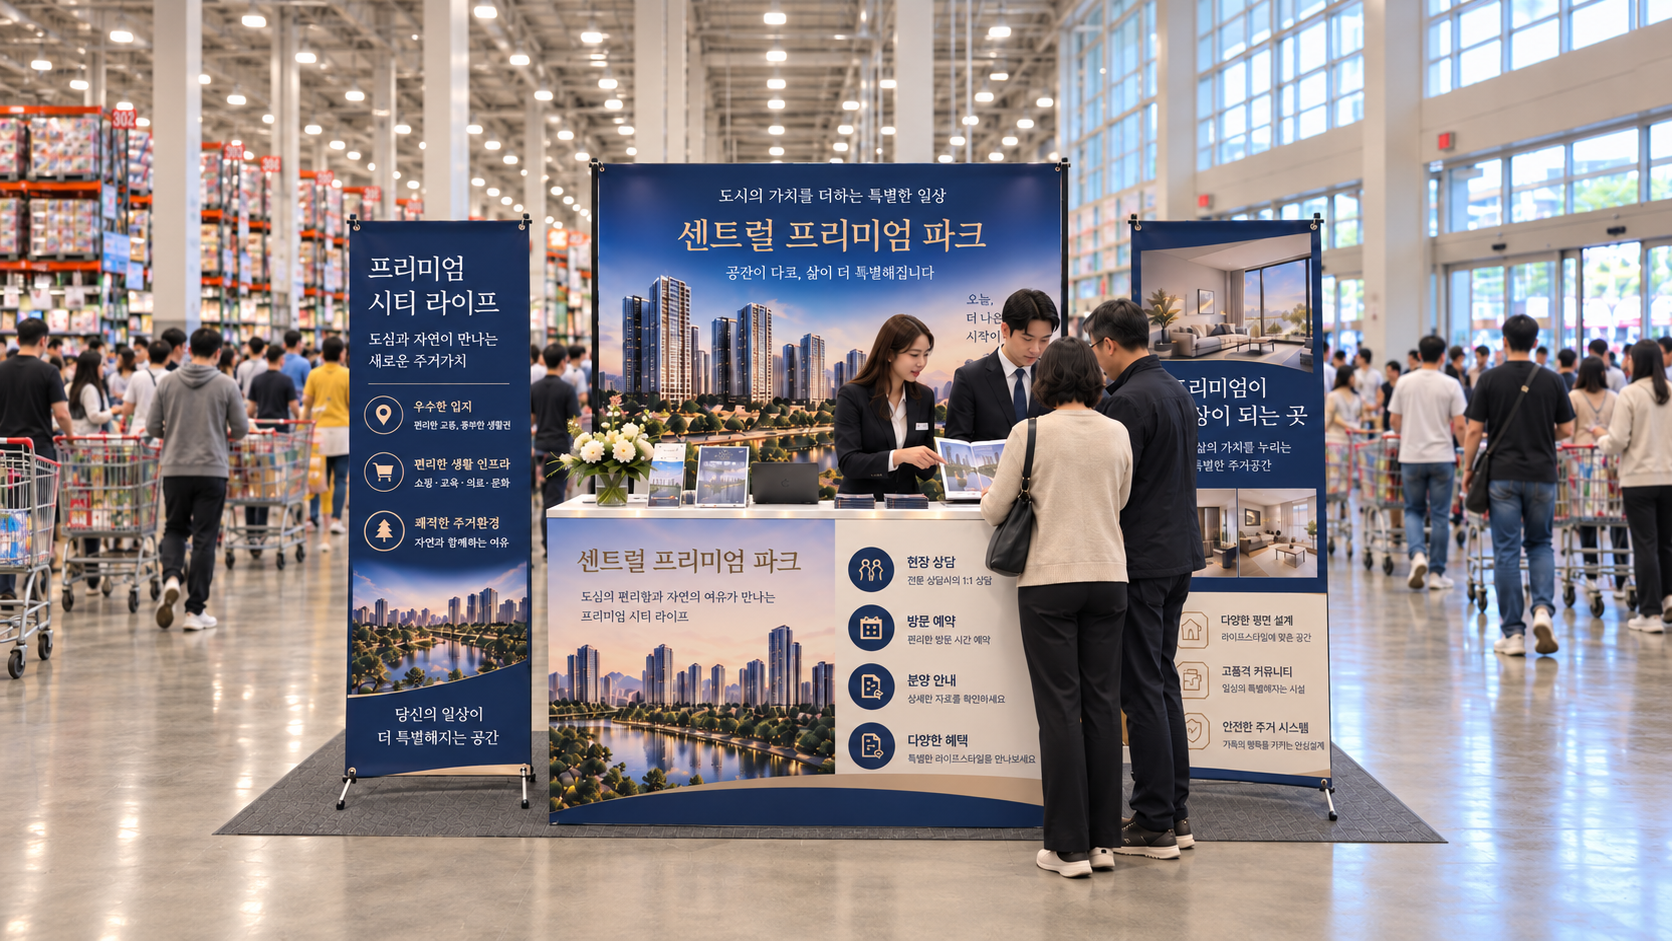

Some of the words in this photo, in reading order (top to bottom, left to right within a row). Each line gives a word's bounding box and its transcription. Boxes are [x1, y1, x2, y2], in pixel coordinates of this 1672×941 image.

[112, 111, 135, 127] 302
[719, 188, 762, 203] 도시의
[769, 188, 813, 203] 가치를
[819, 188, 863, 203] 더하는
[868, 188, 912, 203] 특별한
[918, 188, 946, 203] 일상
[678, 219, 773, 252] 센트럴
[786, 219, 910, 252] 프리미엄
[923, 219, 986, 252] 파크
[368, 255, 463, 281] 프리미엄
[726, 265, 766, 280] 공간이
[807, 265, 831, 280] 삶이
[838, 265, 849, 280] 더
[369, 290, 414, 316] 시티
[427, 290, 499, 315] 라이프
[966, 293, 994, 306] 오늘,
[966, 312, 976, 324] 더
[369, 332, 409, 347] 도심과
[414, 332, 452, 346] 자연이
[458, 332, 498, 346] 만나는
[369, 354, 409, 368] 새로운
[414, 354, 465, 368] 주거가치
[1178, 376, 1266, 398] 리미엄이
[414, 400, 448, 413] 우수한
[450, 400, 472, 413] 입지
[1238, 404, 1280, 426] 되는
[1286, 405, 1308, 426] 곳
[1220, 441, 1254, 454] 가치를
[1258, 441, 1292, 454] 누리는
[477, 458, 510, 470] 인프라
[1228, 460, 1272, 472] 주거공간
[577, 548, 644, 574] 센트럴
[653, 548, 744, 574] 프리미엄
[754, 548, 802, 574] 파크
[907, 556, 930, 569] 현장
[932, 556, 956, 569] 상담
[962, 576, 972, 585] 1:1
[976, 576, 992, 586] 상담
[581, 590, 614, 604] 도심의
[618, 590, 663, 604] 편리함과
[666, 590, 700, 604] 자연의
[704, 590, 738, 604] 여유가
[741, 590, 776, 604] 만나는
[581, 610, 626, 623] 프리미엄
[629, 610, 650, 623] 시티
[654, 610, 688, 623] 라이프
[907, 615, 930, 628] 방문
[932, 615, 956, 628] 예약
[1220, 615, 1250, 626] 다양한
[954, 635, 972, 645] 시간
[974, 635, 991, 645] 예약
[1254, 666, 1292, 678] 커뮤니티
[908, 674, 930, 687] 분양
[933, 674, 956, 687] 안내
[396, 707, 436, 722] 당신의
[442, 707, 482, 722] 일상이
[1222, 720, 1253, 733] 안전한
[1256, 722, 1276, 734] 주거
[378, 730, 390, 745] 더
[396, 730, 466, 745] 특별해지는
[471, 730, 499, 745] 공간
[908, 734, 942, 747] 다양한
